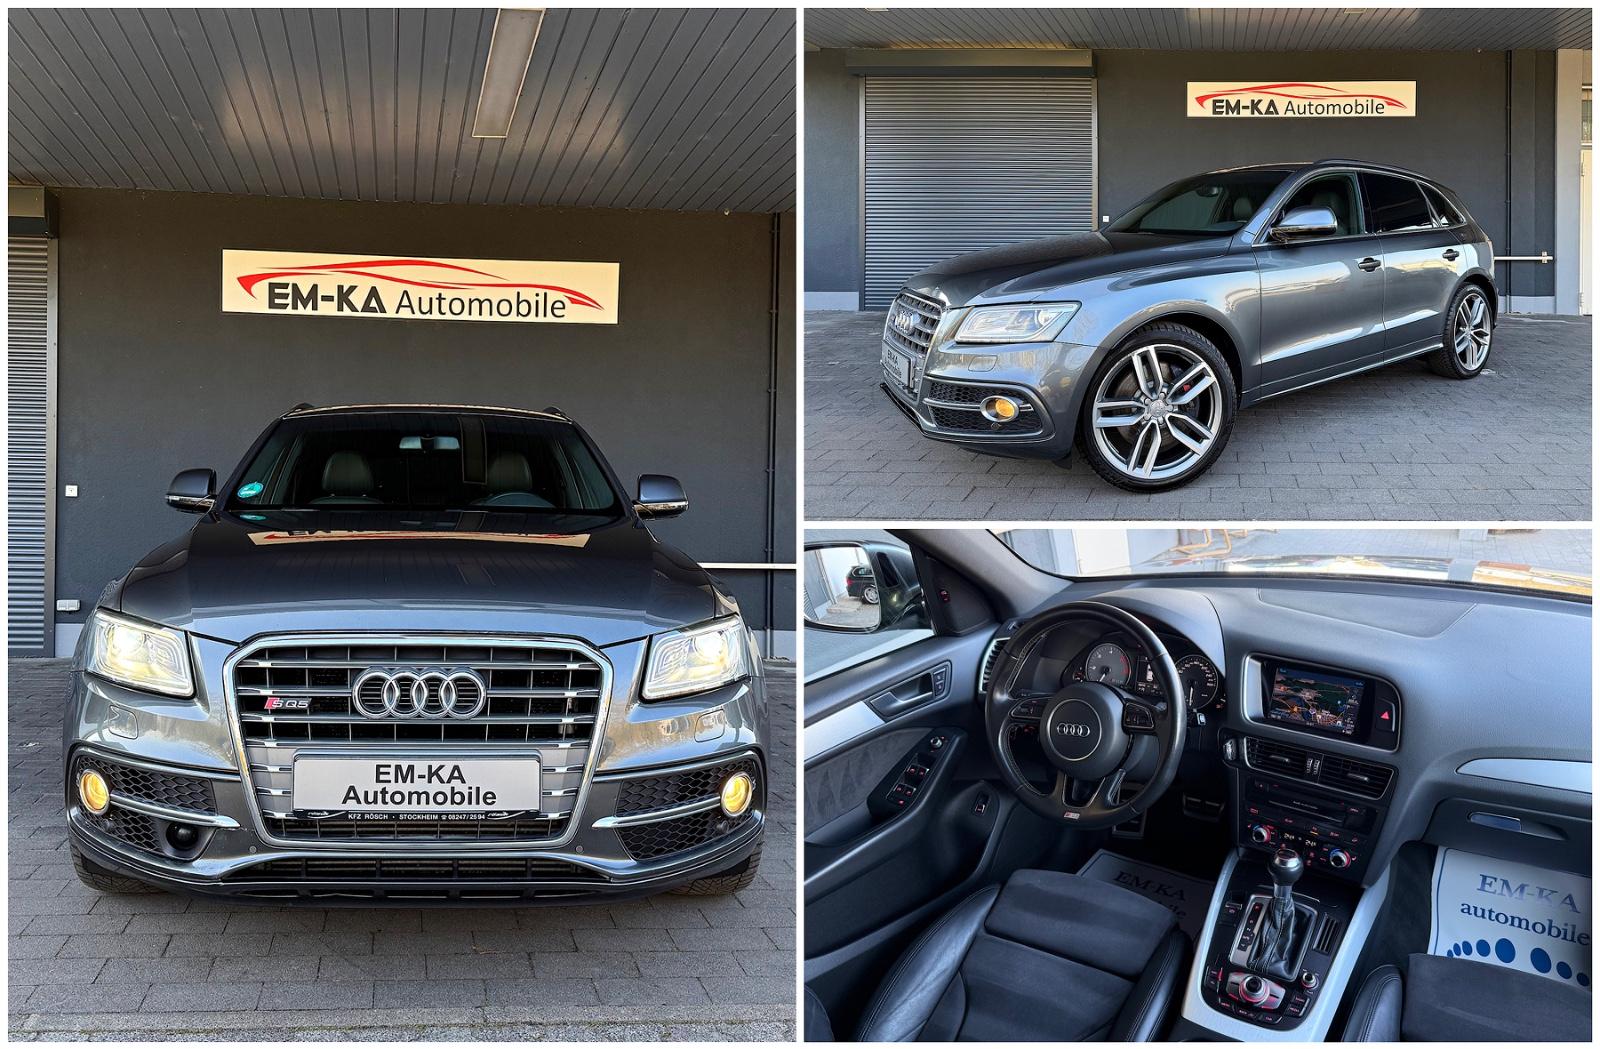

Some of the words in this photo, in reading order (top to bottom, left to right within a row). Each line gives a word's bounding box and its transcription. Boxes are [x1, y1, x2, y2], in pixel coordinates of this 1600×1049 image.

[1212, 99, 1279, 116] EM-KA
[1284, 99, 1385, 116] Automobile
[267, 282, 387, 314] EM-KA
[396, 289, 566, 318] Automobile
[375, 764, 466, 784] EM-KA
[341, 786, 497, 806] Automobile
[365, 812, 388, 820] RÖSCH
[1476, 873, 1581, 914] EM-KA
[1460, 902, 1590, 946] automobile
